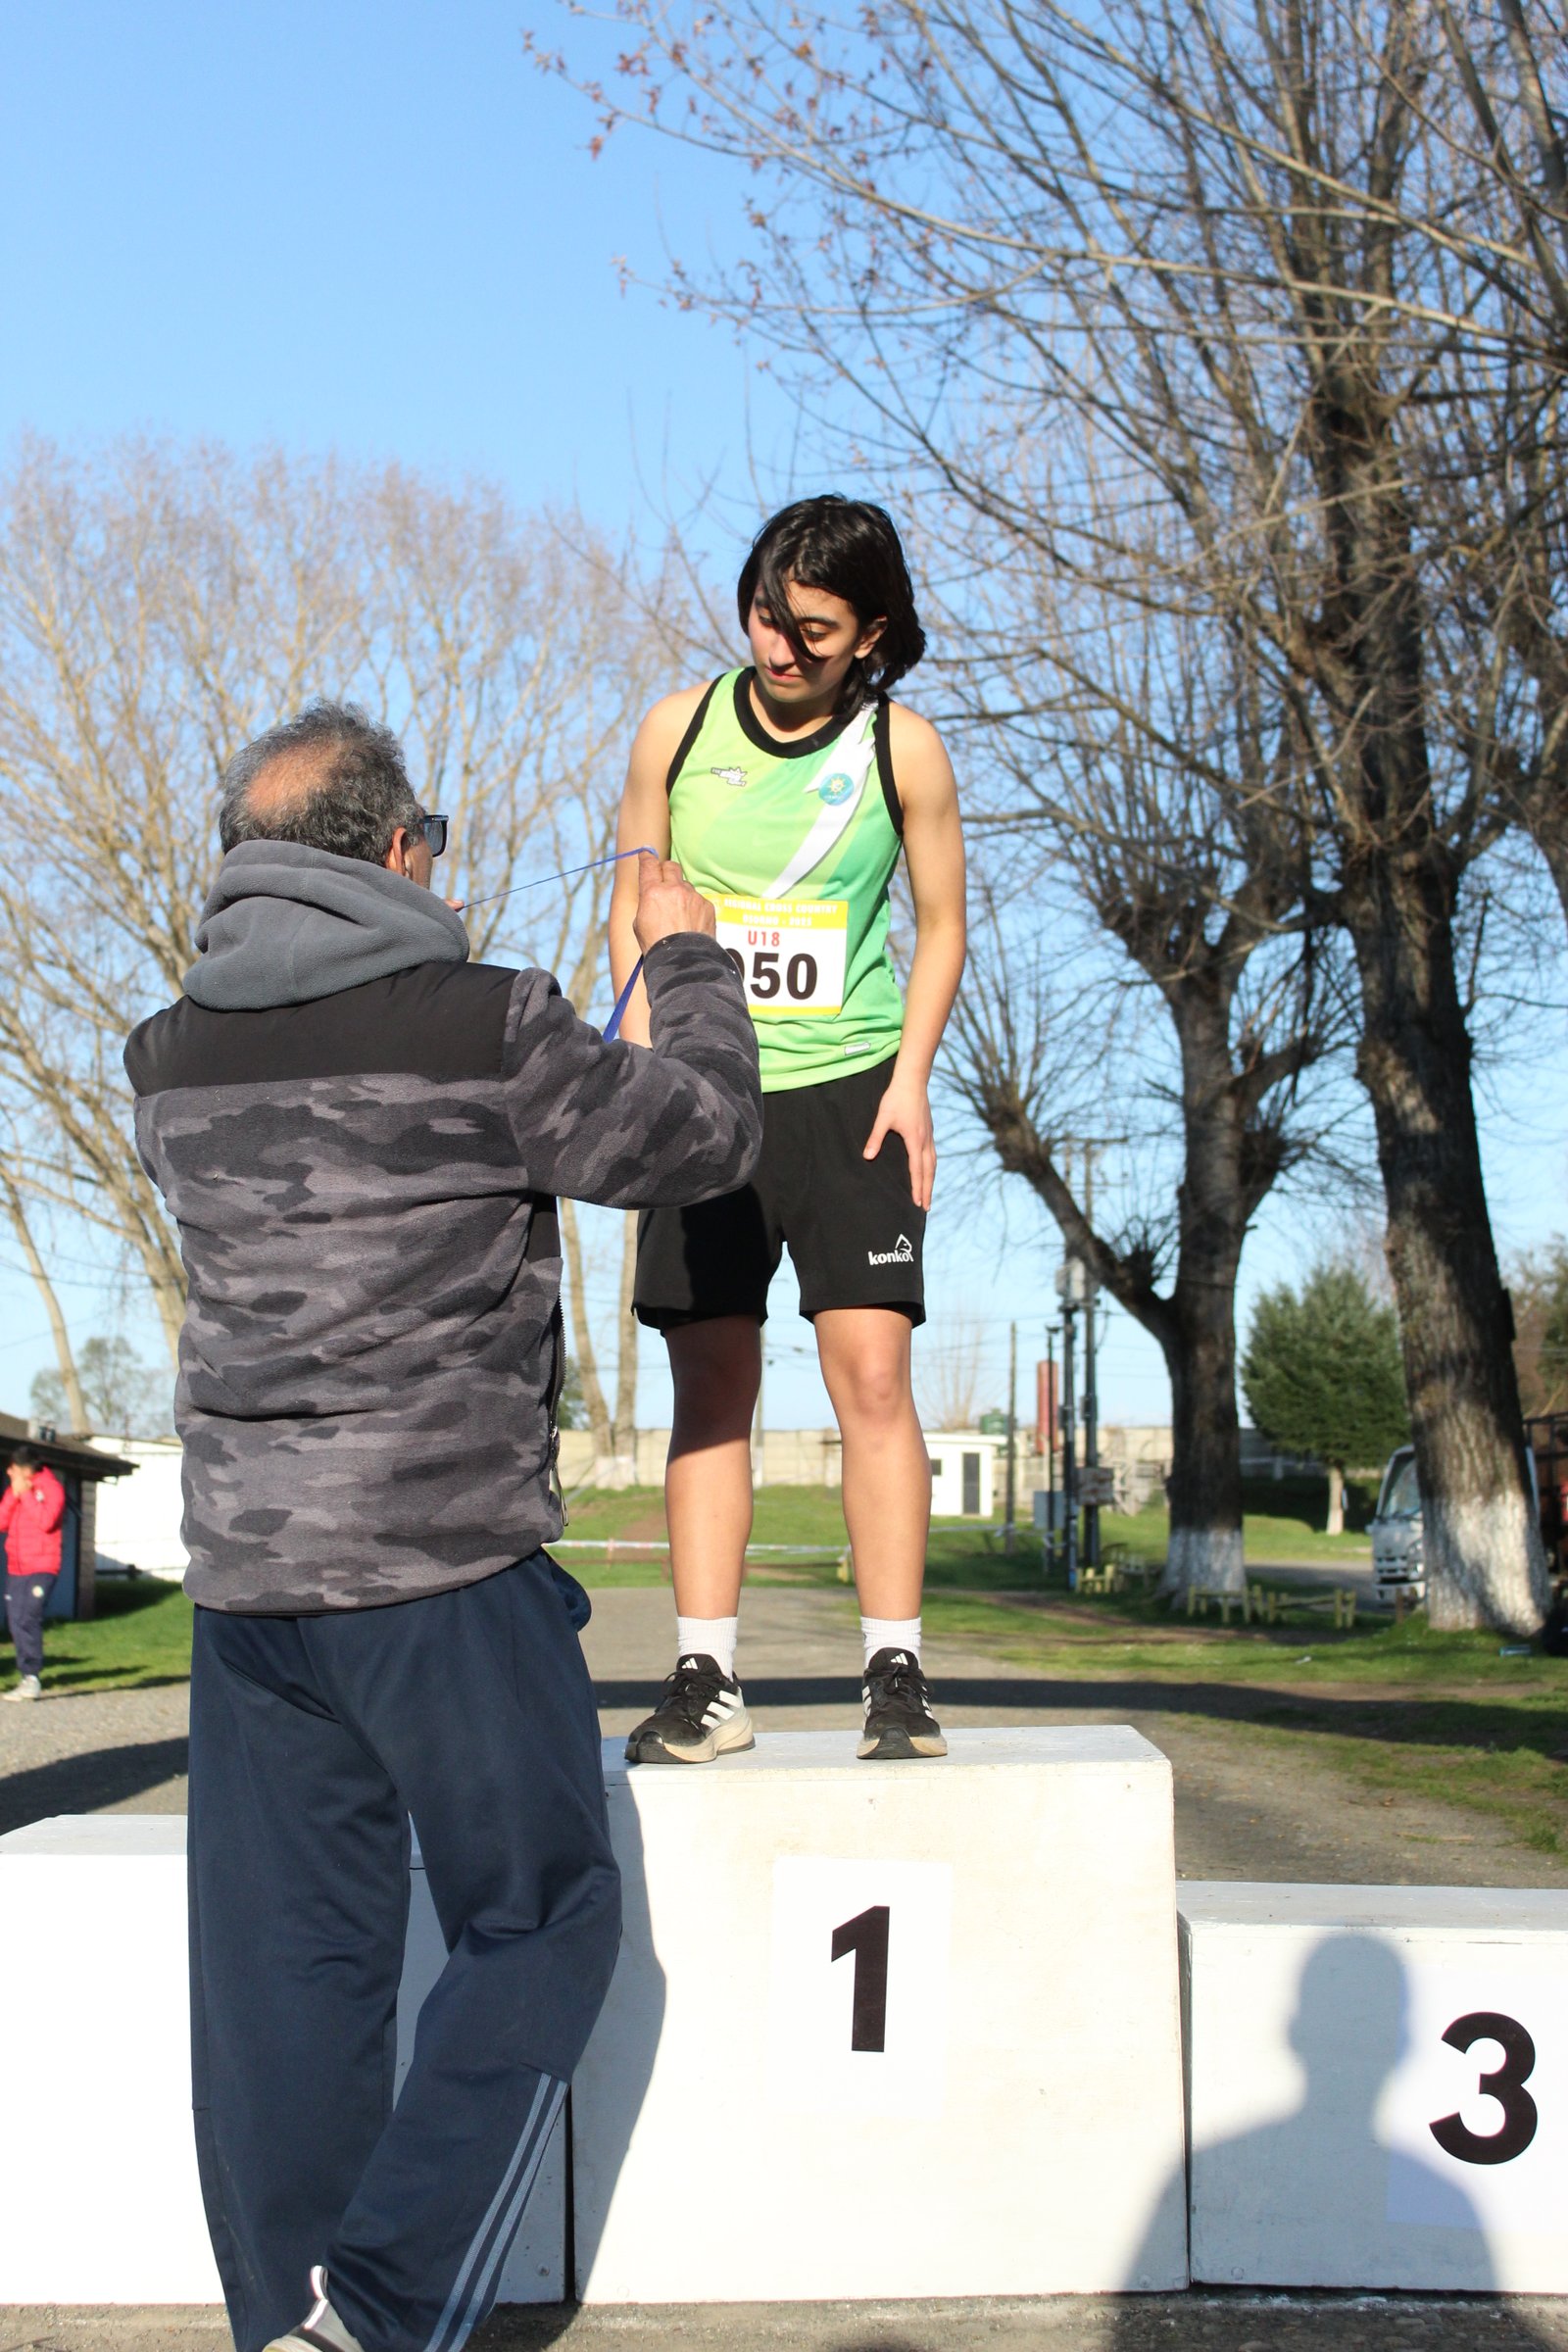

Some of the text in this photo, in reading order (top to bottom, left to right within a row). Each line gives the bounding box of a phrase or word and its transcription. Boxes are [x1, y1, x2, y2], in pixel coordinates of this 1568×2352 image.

[723, 898, 838, 915] REGIONAL CROSS COUNTRY
[742, 912, 779, 925] OSORNO
[748, 930, 780, 947] U18
[831, 1905, 890, 2053] 1
[1429, 2011, 1538, 2166] 3
